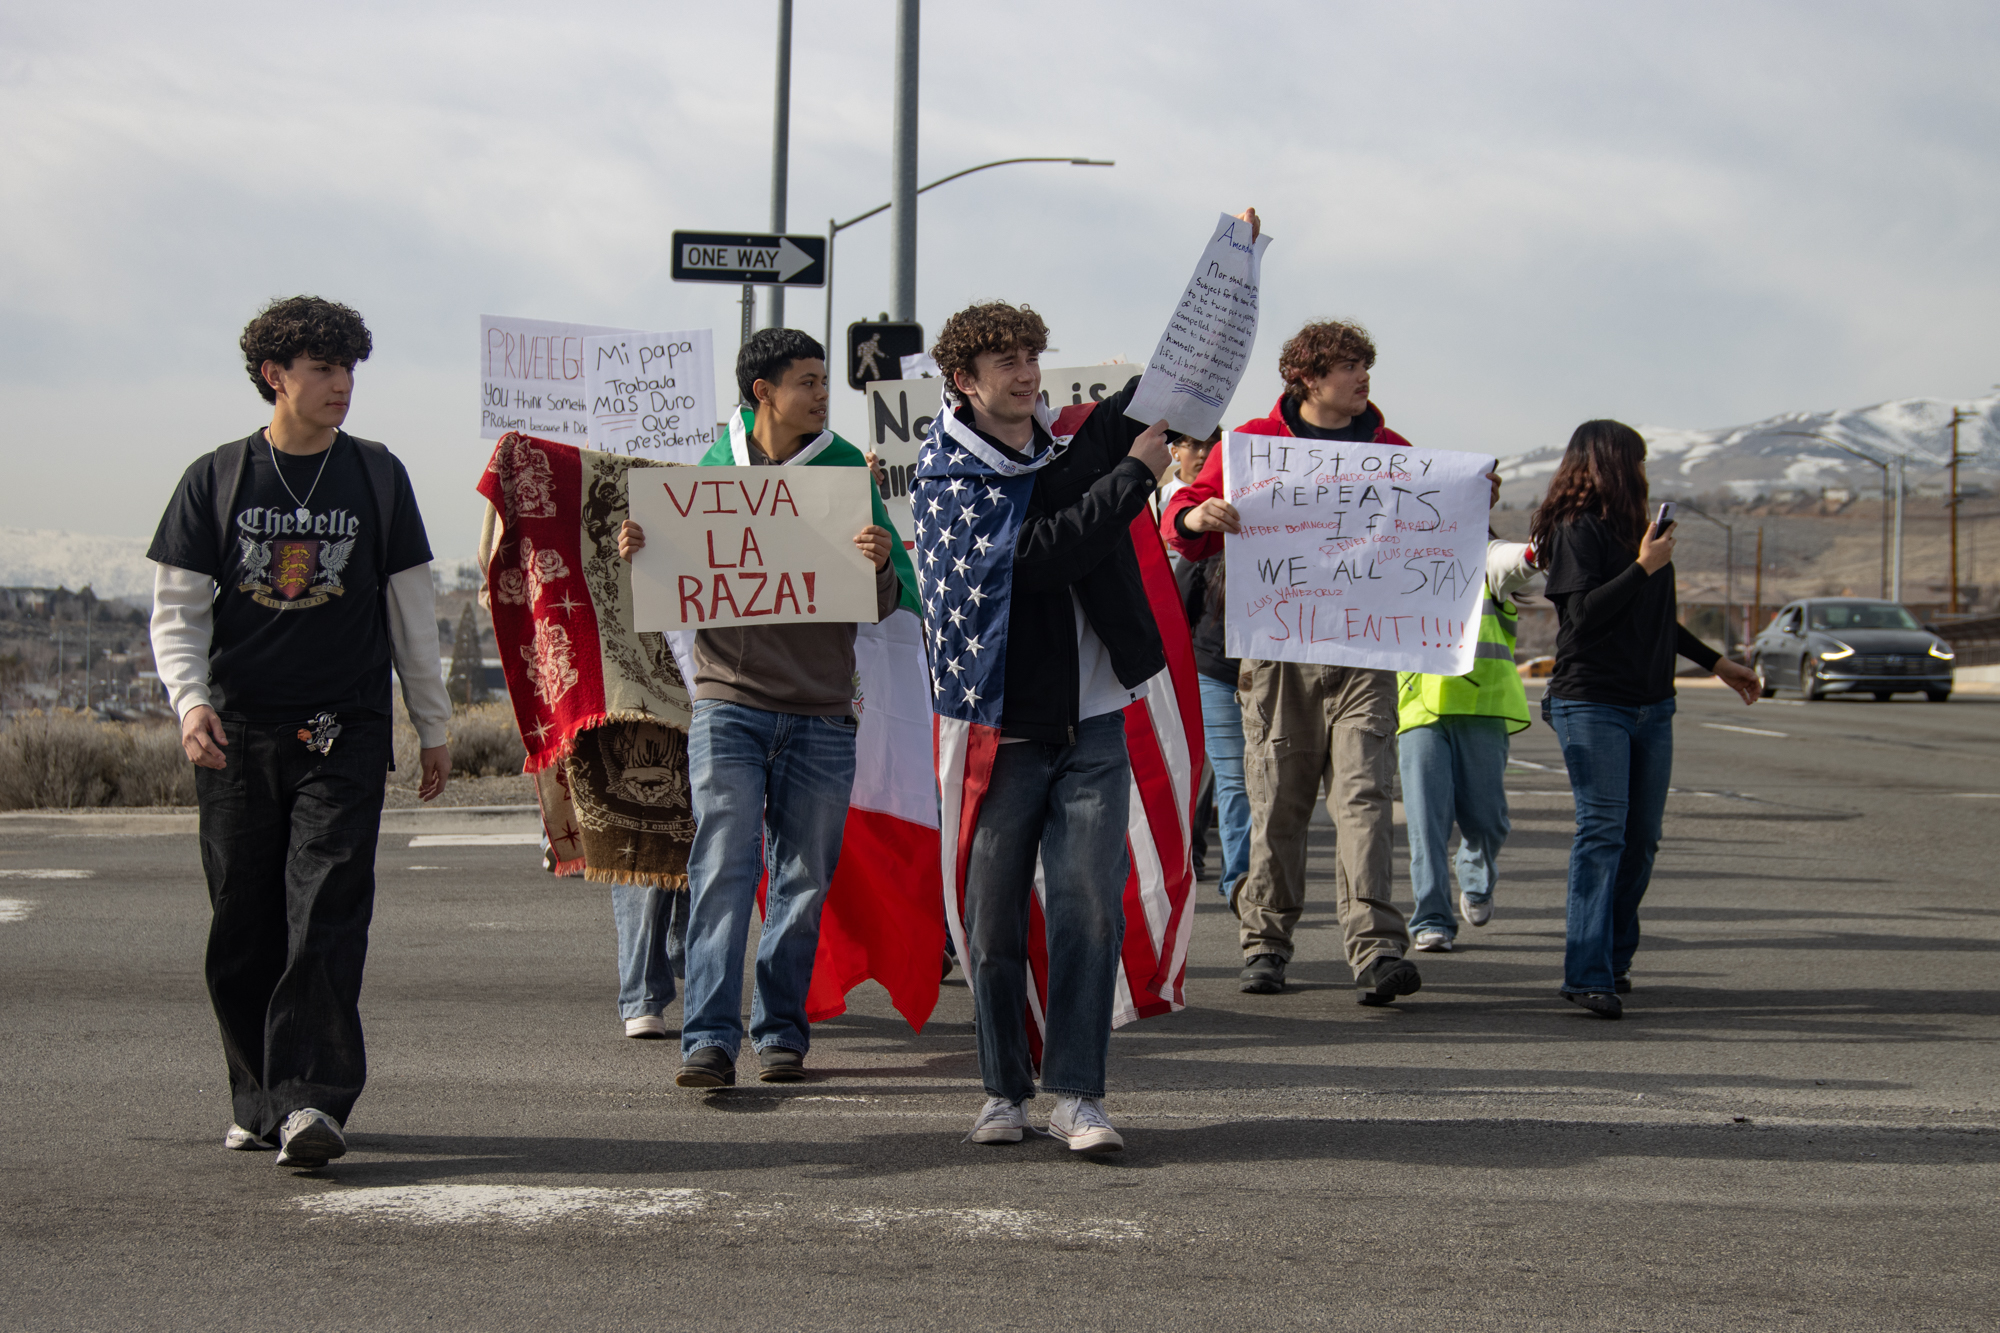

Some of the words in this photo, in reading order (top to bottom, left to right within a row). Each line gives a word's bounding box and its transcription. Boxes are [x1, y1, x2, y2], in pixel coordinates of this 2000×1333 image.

[688, 247, 728, 266] ONE
[737, 248, 779, 268] WAY
[597, 342, 630, 371] Mi
[639, 341, 693, 374] papa
[650, 391, 695, 413] Duro
[642, 414, 681, 434] Que
[663, 478, 799, 517] VIVA
[1230, 486, 1254, 501] ALEX
[1272, 481, 1441, 531] REPEATS
[1240, 525, 1281, 540] HEBER
[1439, 519, 1458, 533] LA
[707, 526, 764, 568] LA
[1319, 537, 1367, 558] RENEE
[1372, 534, 1401, 544] GOOD
[1377, 548, 1401, 565] LUIS
[1404, 547, 1455, 558] CACERES
[1257, 556, 1308, 586] WE
[1333, 559, 1382, 585] ALL
[1400, 556, 1478, 601] STAY
[257, 596, 323, 608] CHICAGO
[678, 571, 817, 623] RAZA!
[1246, 594, 1272, 617] LUIS
